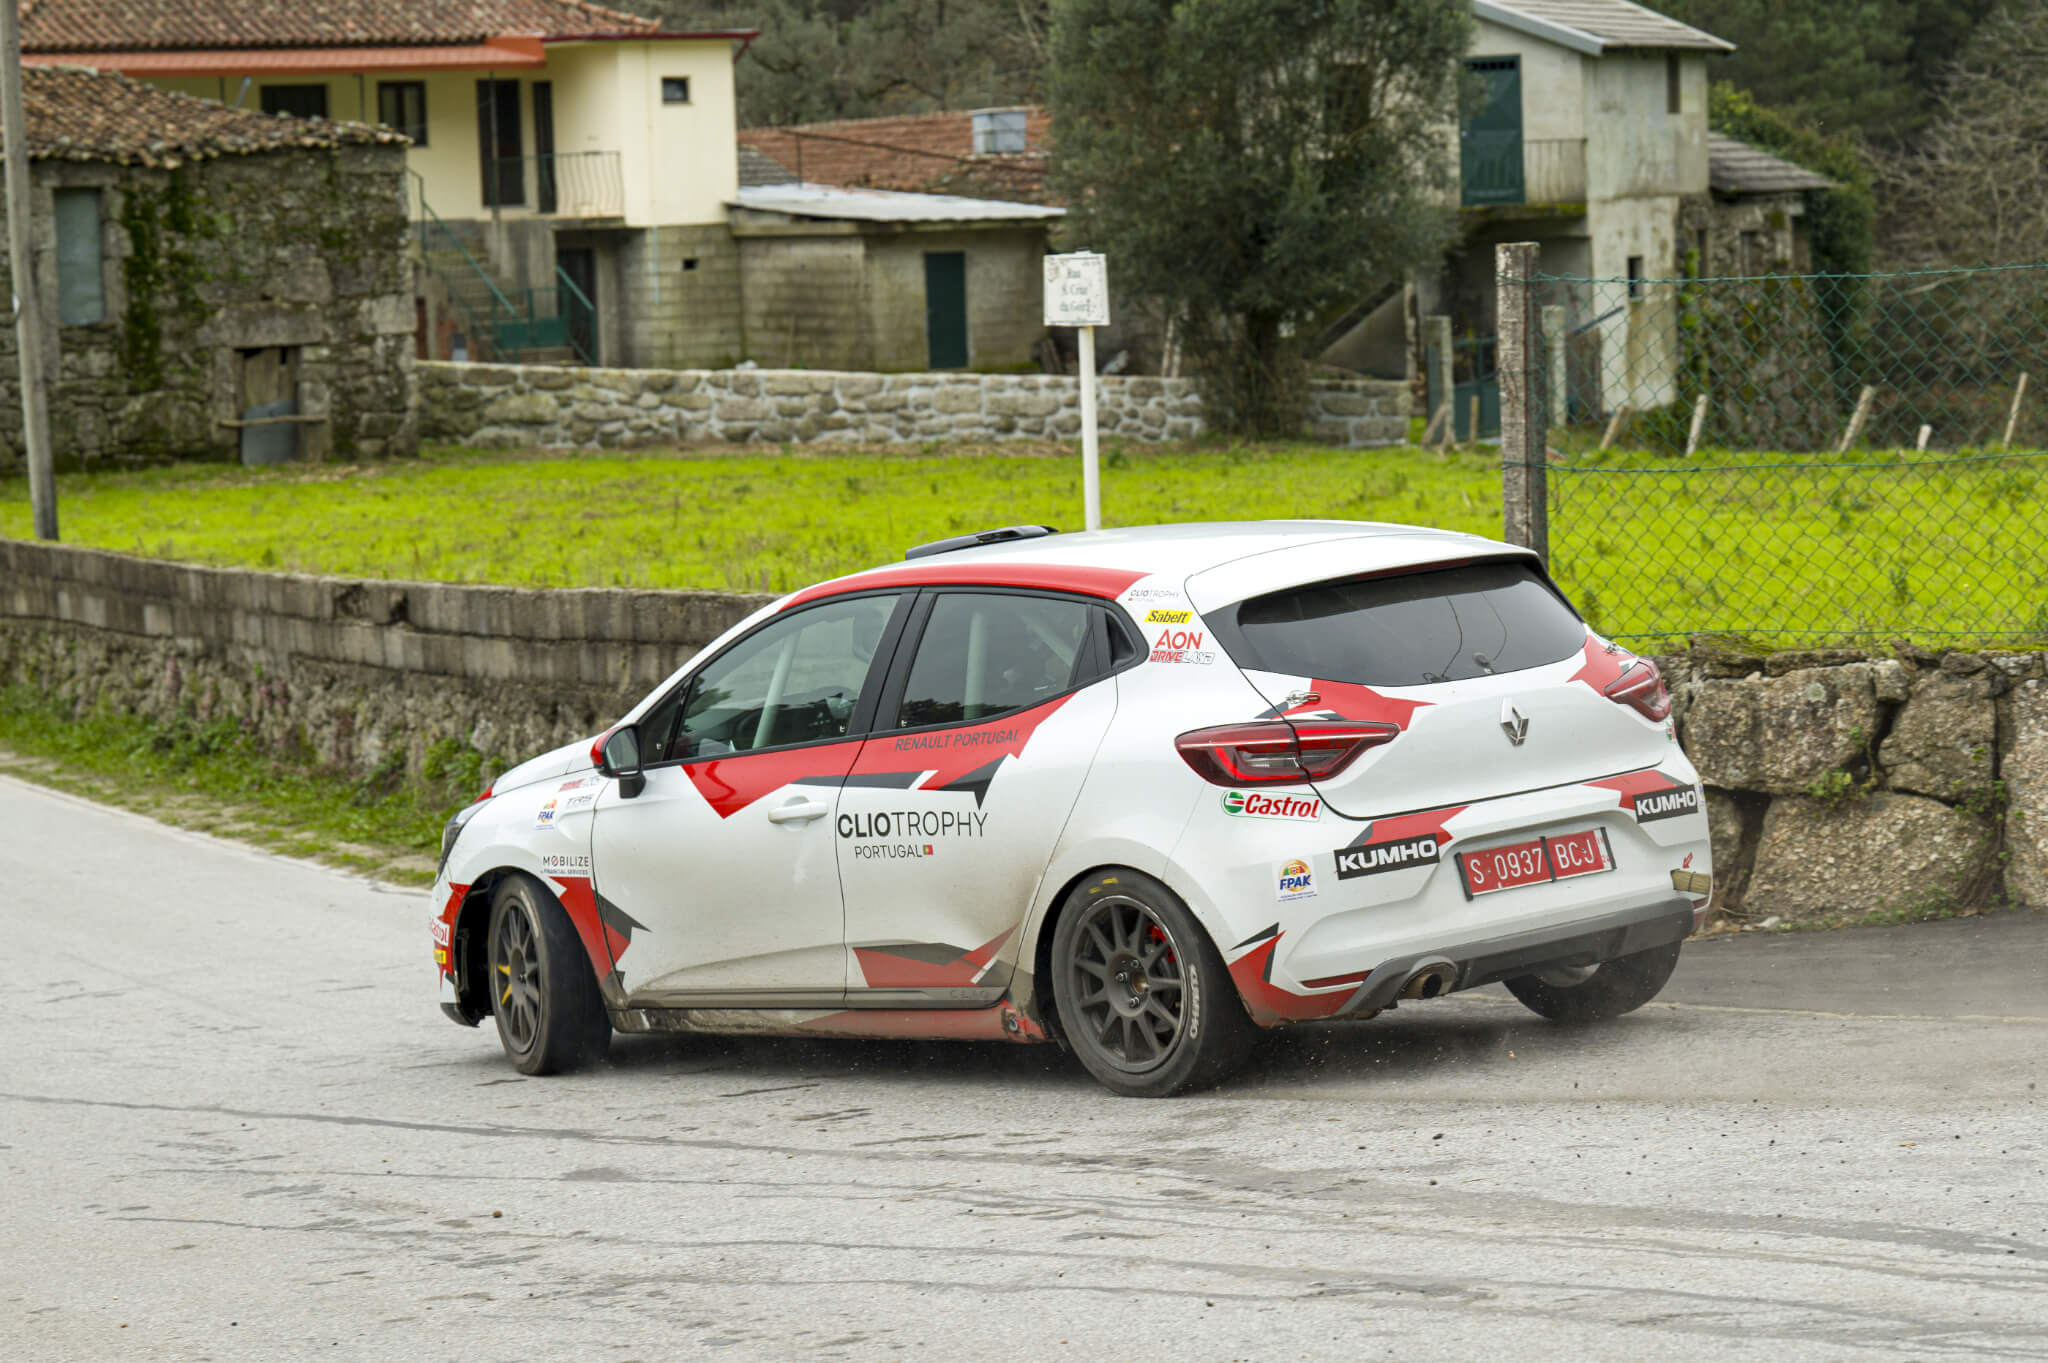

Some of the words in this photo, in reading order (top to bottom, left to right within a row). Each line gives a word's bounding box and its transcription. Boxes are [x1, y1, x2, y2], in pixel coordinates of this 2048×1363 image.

[1148, 611, 1189, 624] Sabelt
[1155, 629, 1202, 650] AON
[895, 735, 952, 752] RENAULT
[953, 729, 1019, 747] PORTUGAL
[1245, 793, 1319, 818] Castrol
[1635, 790, 1697, 817] KUMHO
[837, 811, 988, 838] CLIOTROPHY
[854, 844, 923, 859] PORTUGAL
[1338, 838, 1437, 872] KUMHO
[1494, 847, 1542, 880] 0937
[1555, 839, 1594, 869] BCJ
[1279, 874, 1312, 890] FPAK
